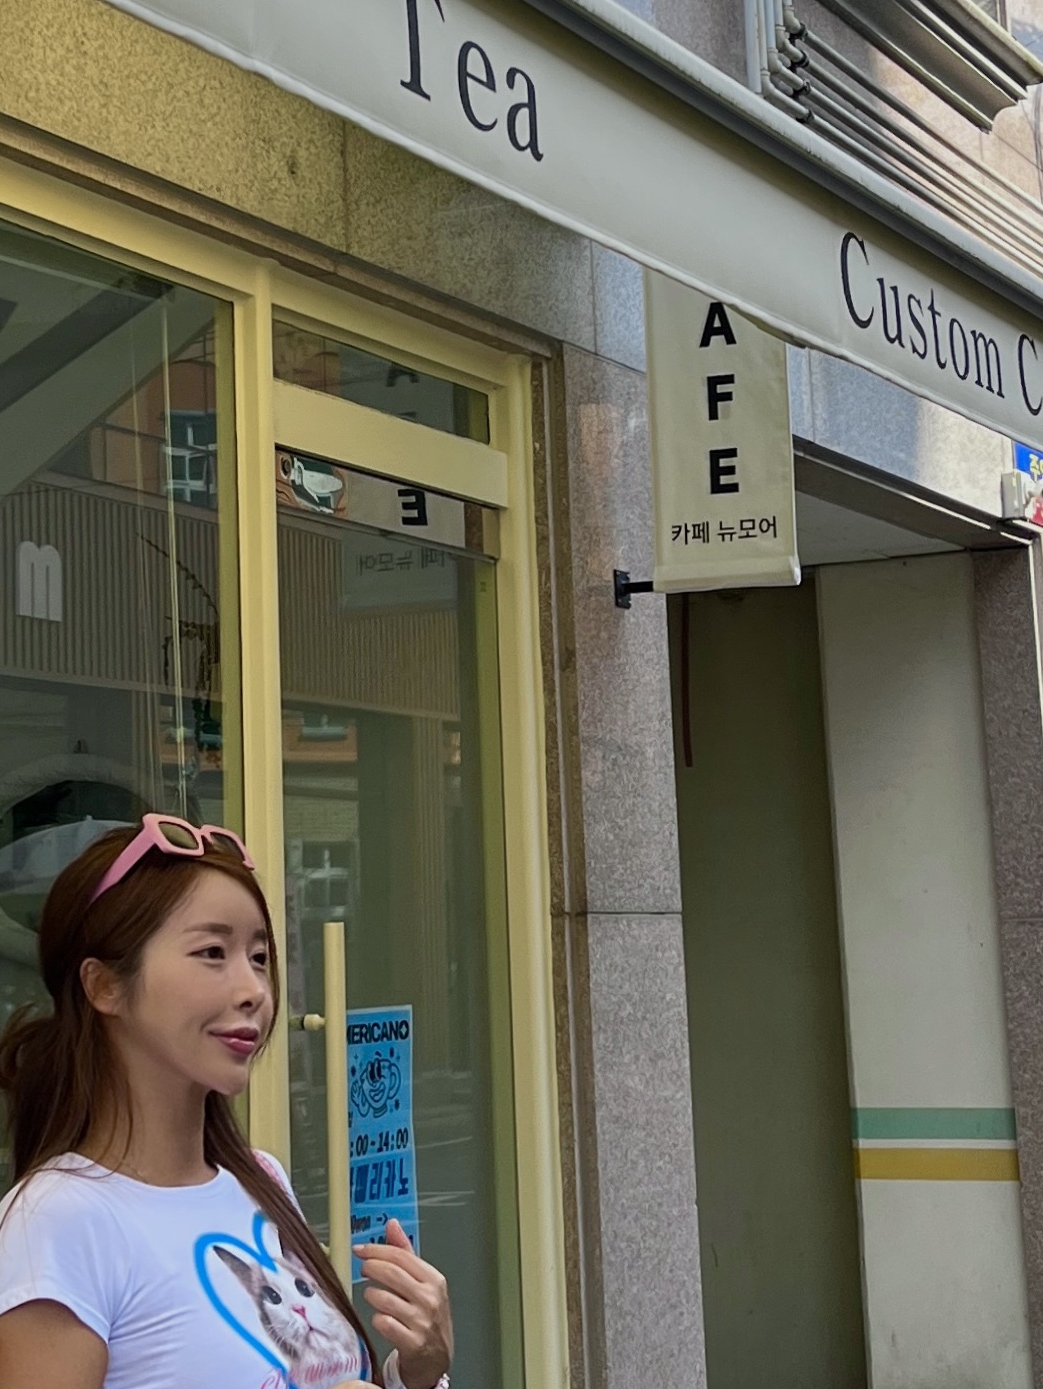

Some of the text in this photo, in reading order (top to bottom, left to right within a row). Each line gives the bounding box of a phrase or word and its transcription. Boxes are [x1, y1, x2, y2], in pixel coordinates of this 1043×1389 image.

[400, 0, 544, 162] Tea
[840, 231, 1005, 399] Custom
[671, 516, 778, 545] 카페 뉴모어
